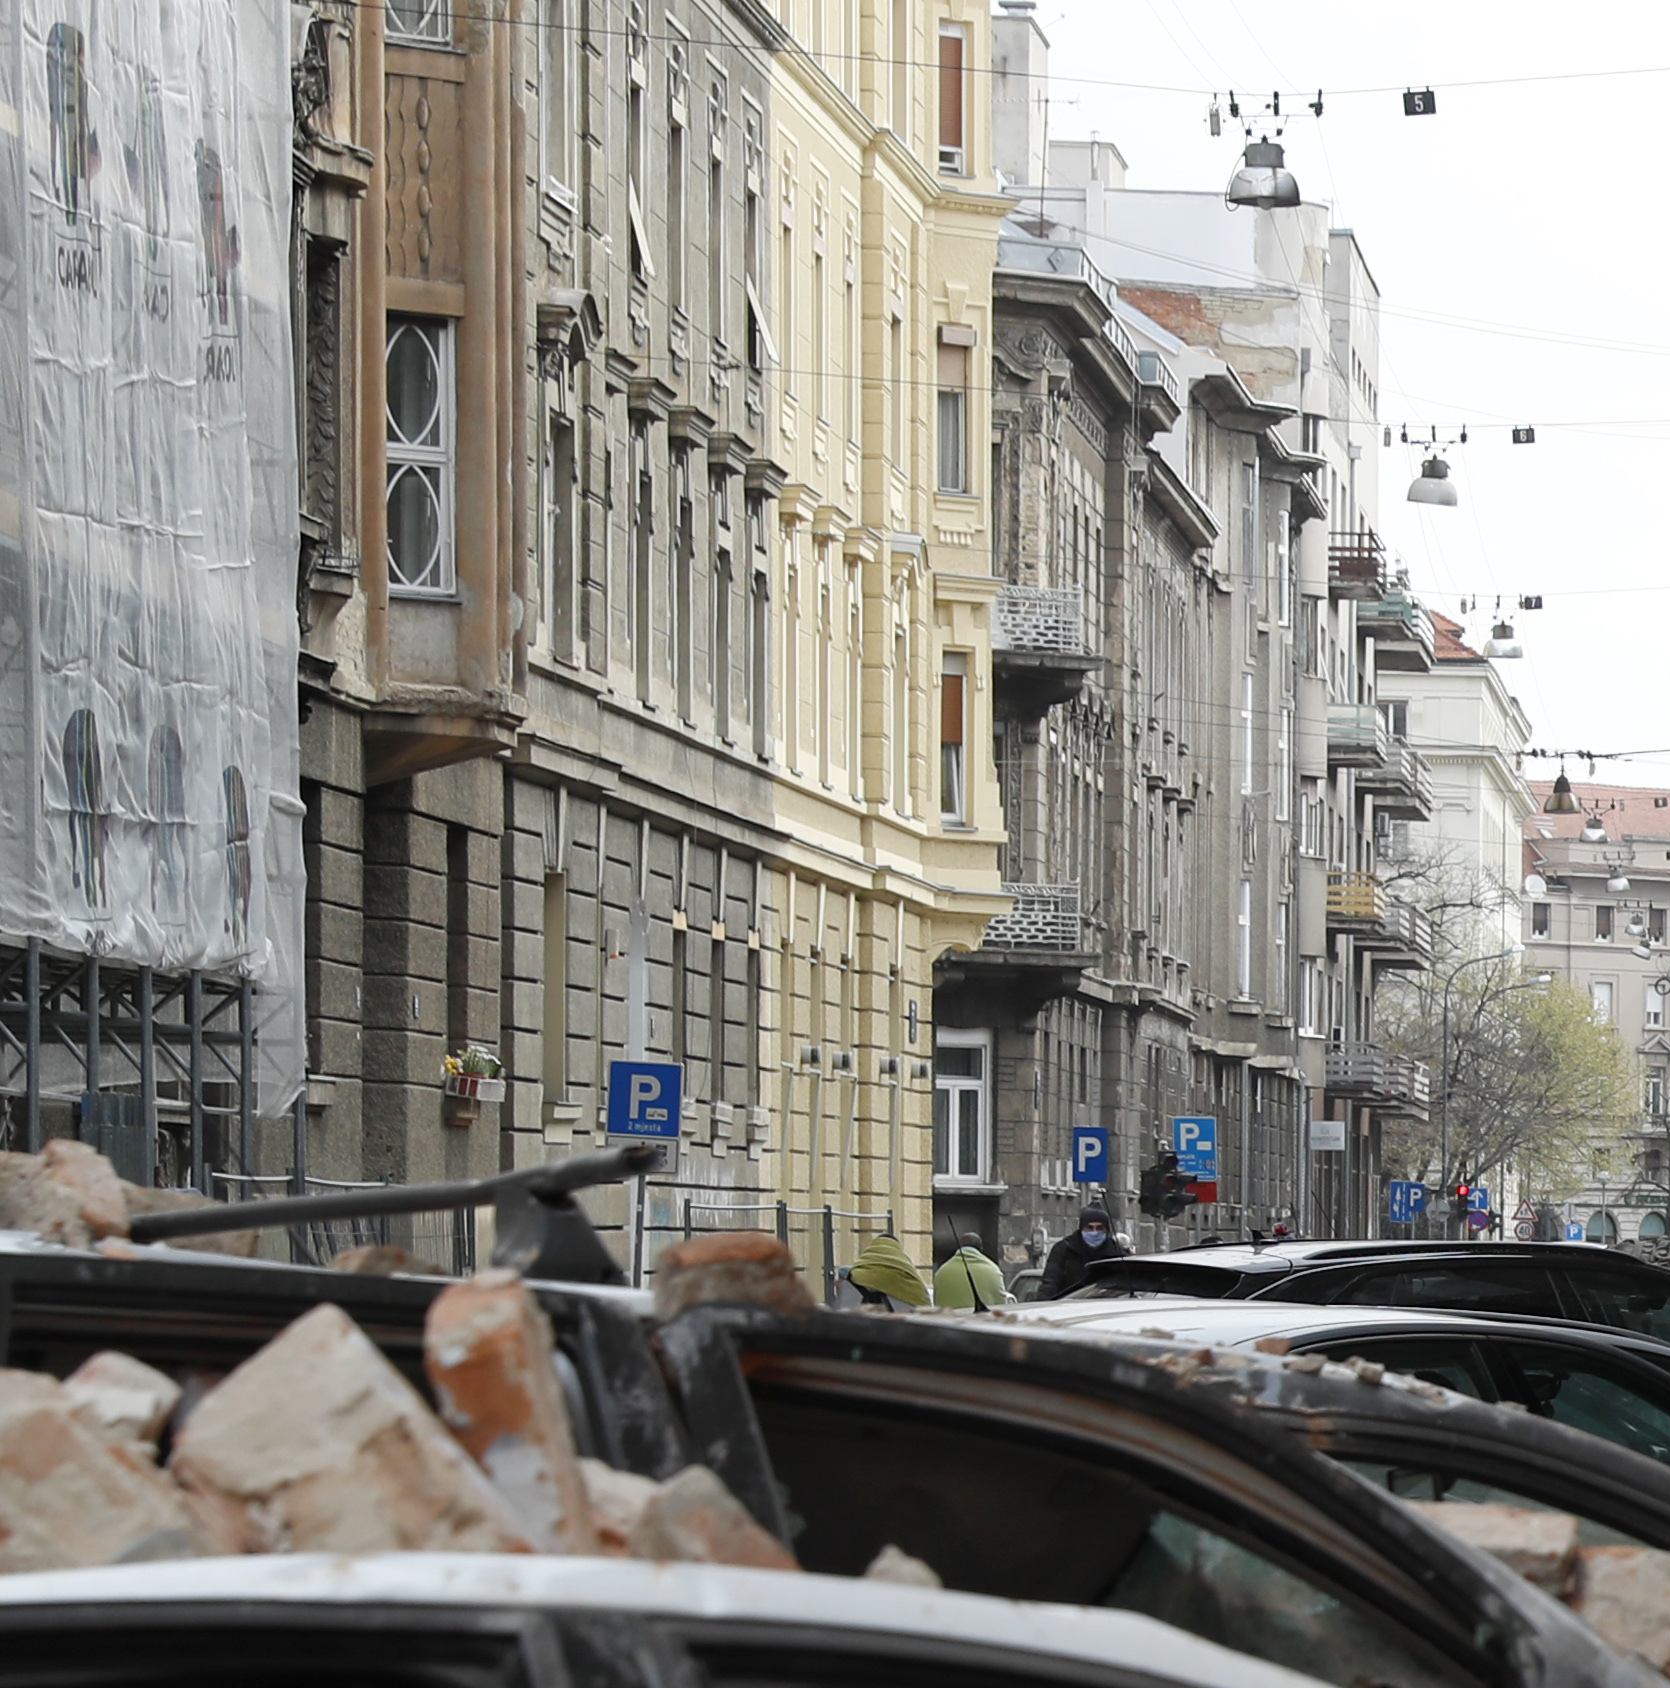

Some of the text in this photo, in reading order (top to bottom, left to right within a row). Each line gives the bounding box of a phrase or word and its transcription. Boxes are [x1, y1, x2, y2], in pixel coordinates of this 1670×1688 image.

[630, 1074, 661, 1119] P
[628, 1121, 661, 1133] 2 mjesta
[1180, 1123, 1200, 1151] P
[1079, 1136, 1101, 1172] P
[1410, 1188, 1421, 1207] P
[1519, 1226, 1530, 1236] 40
[1570, 1227, 1578, 1238] P
